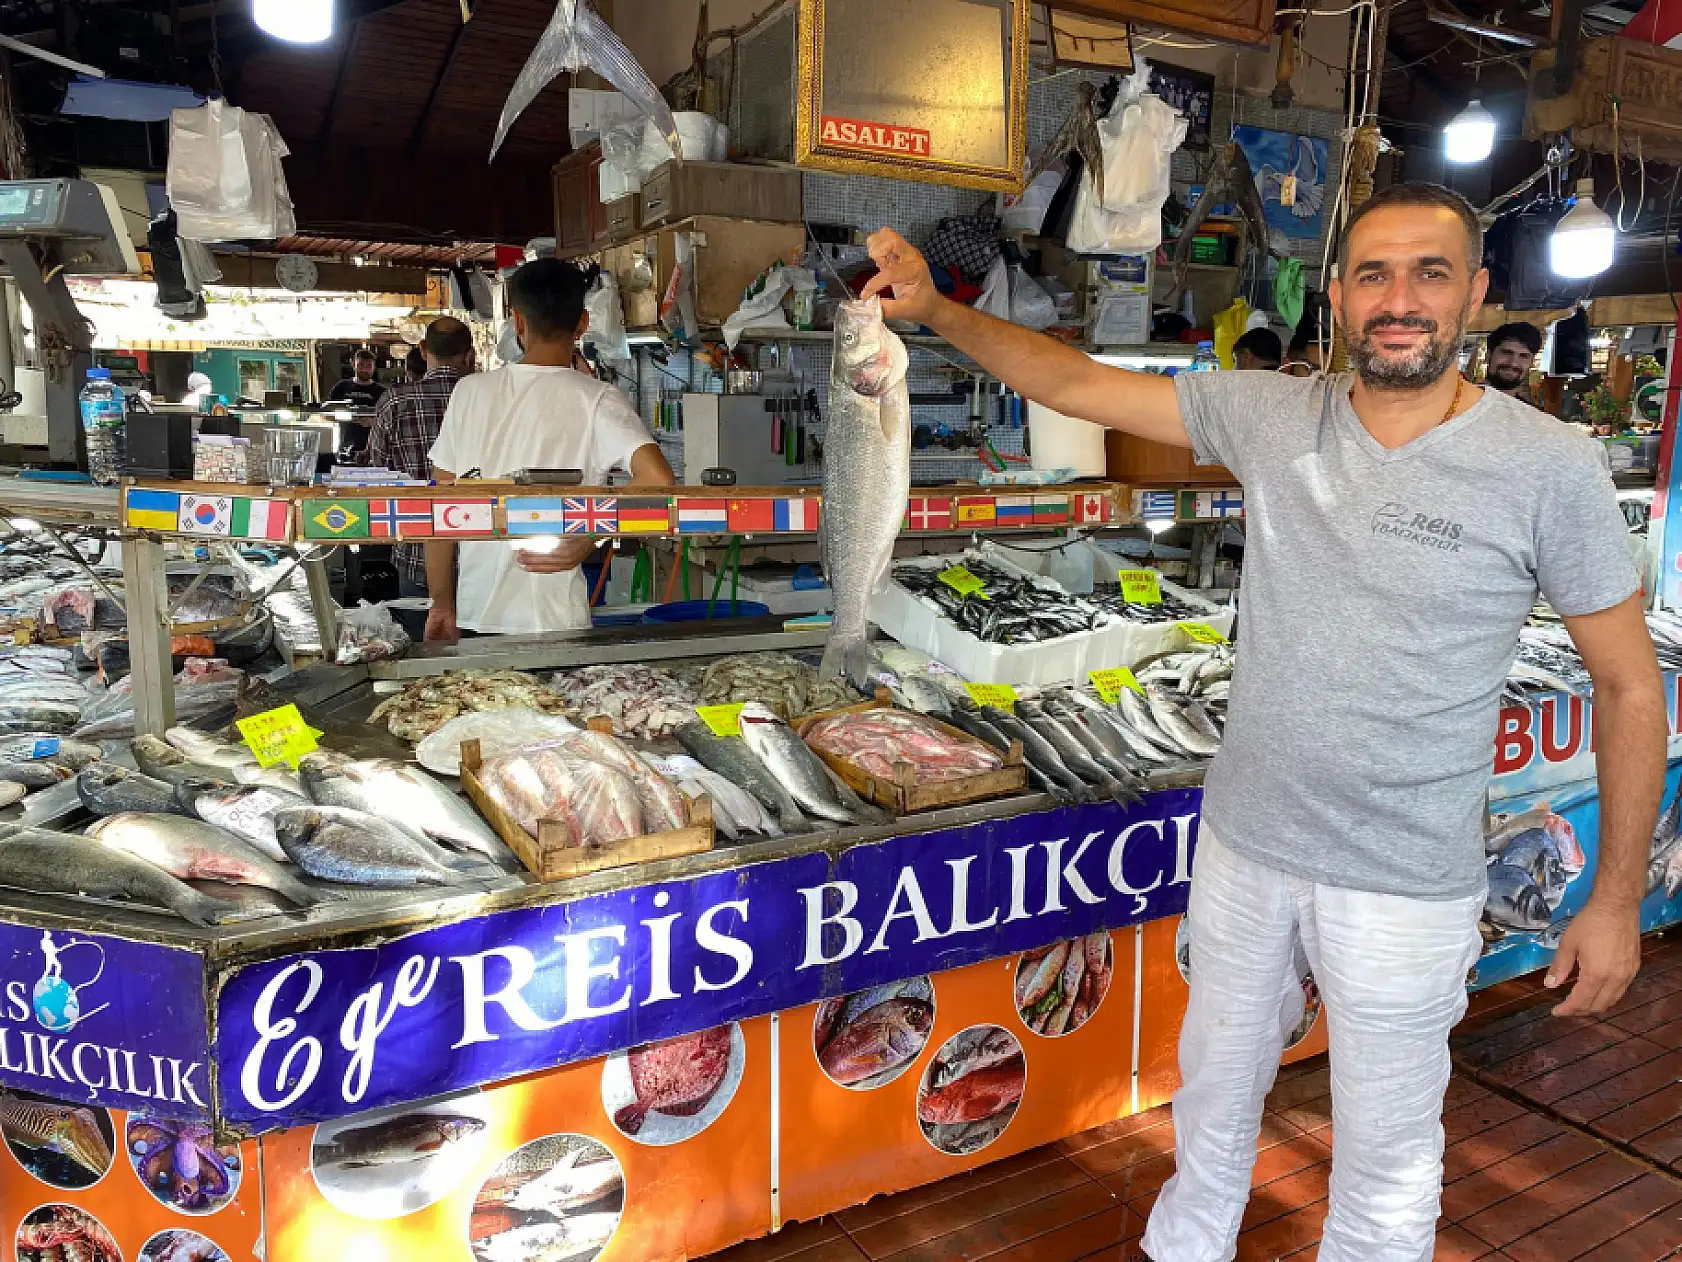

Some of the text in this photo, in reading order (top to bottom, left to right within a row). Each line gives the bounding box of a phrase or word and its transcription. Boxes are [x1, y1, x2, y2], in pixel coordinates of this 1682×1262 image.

[822, 120, 929, 154] ASALET
[240, 811, 1198, 1112] Ege REİS BALIKÇI
